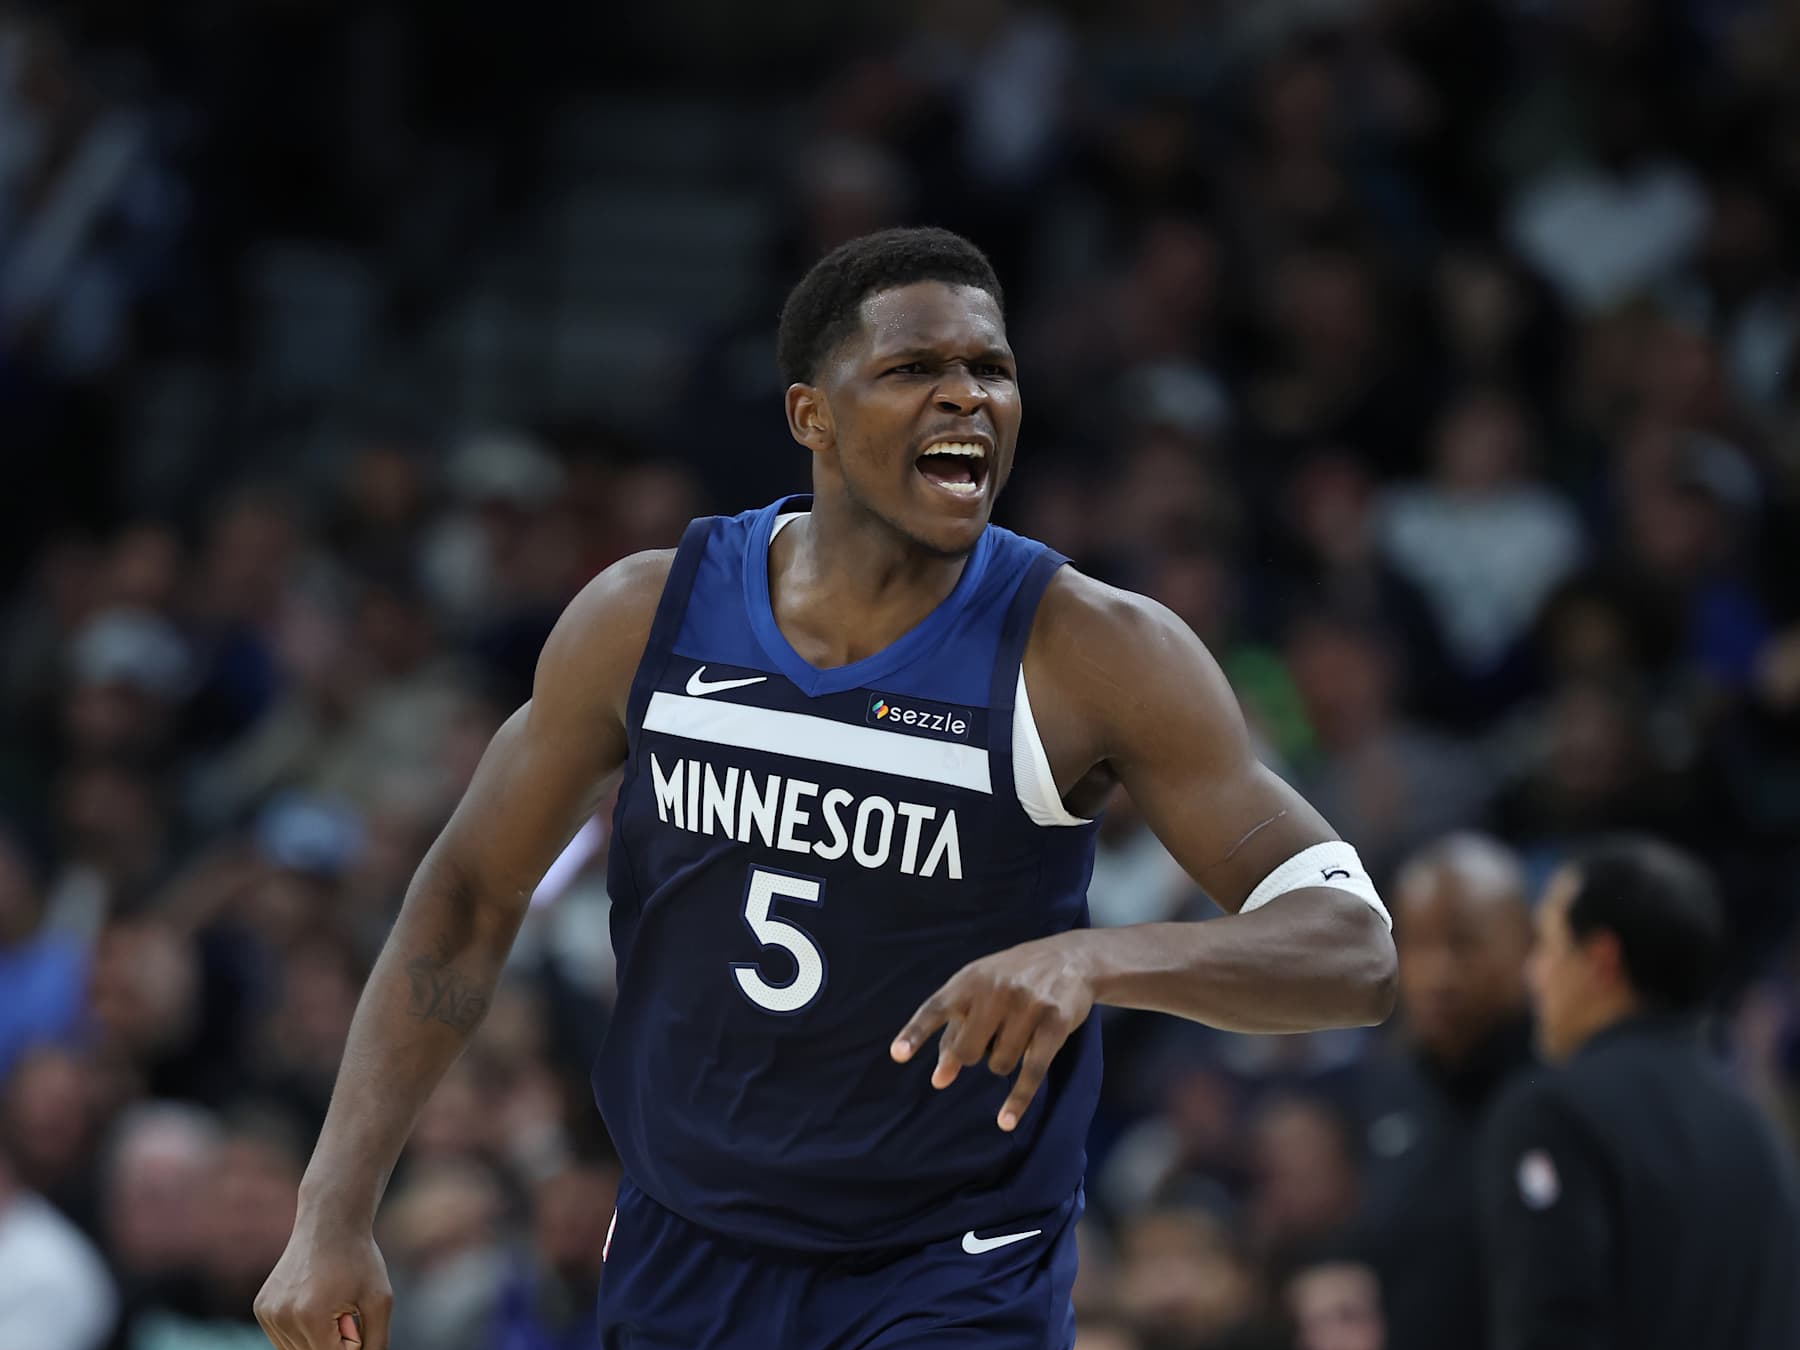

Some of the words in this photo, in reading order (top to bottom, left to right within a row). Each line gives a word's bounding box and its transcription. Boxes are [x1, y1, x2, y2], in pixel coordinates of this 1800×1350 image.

[889, 707, 966, 734] sezzle
[650, 753, 963, 880] MINNESOTA
[730, 864, 826, 1014] 5
